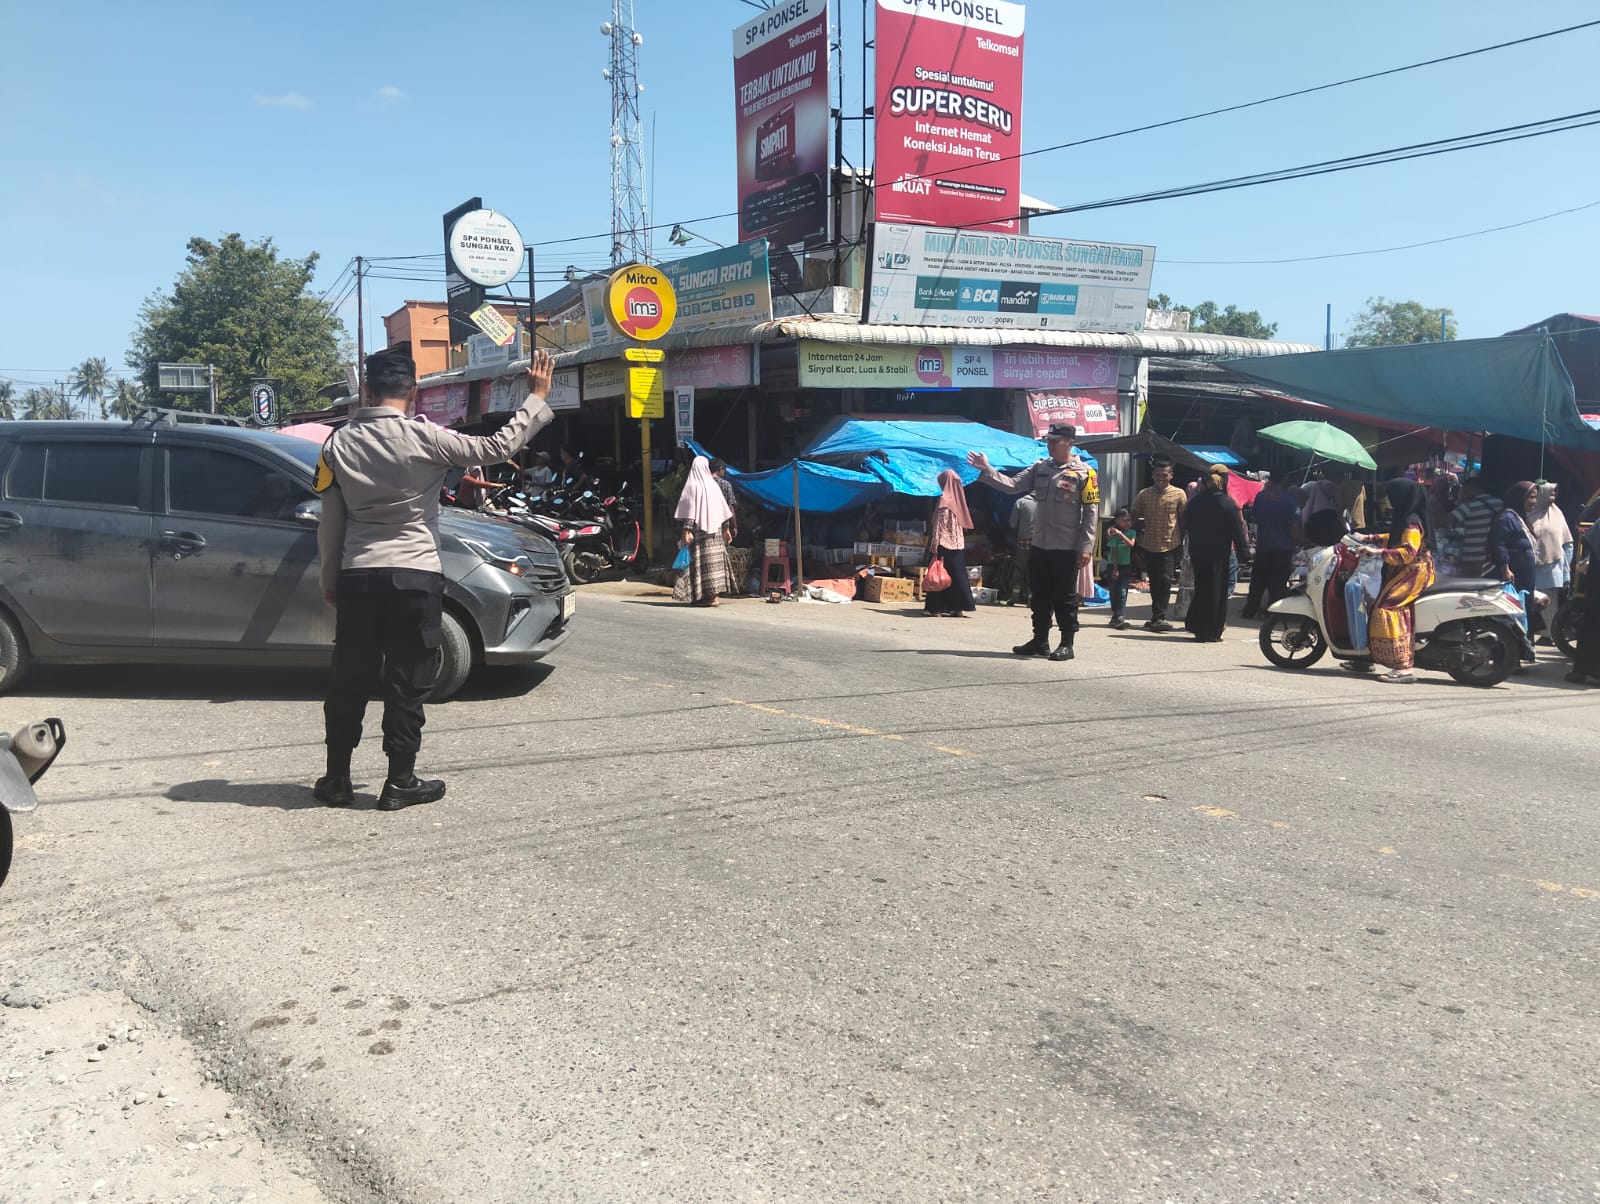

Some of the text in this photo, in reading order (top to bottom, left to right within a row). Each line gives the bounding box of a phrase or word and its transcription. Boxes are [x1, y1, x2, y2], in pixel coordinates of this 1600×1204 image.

[941, 0, 1003, 25] PONSEL
[745, 0, 809, 45] SP 4 PONSEL
[787, 24, 823, 48] Telkomsel
[975, 37, 1019, 57] Telkomsel
[740, 50, 817, 106] TERBAIK UNTUKMU
[915, 66, 994, 91] Spesial untukmu!
[890, 87, 1012, 132] SUPER SERU
[915, 120, 992, 144] Internet Hemat
[760, 124, 788, 159] SIMPATI
[903, 136, 1001, 161] Koneksi Jalan Terus
[901, 181, 932, 196] KUAT
[460, 241, 515, 252] SUNGAI RAYA
[463, 234, 512, 245] SP4 PONSEL
[924, 231, 957, 254] MINI
[957, 235, 989, 256] ATM
[1017, 239, 1063, 261] PONSEL
[1064, 242, 1110, 266] SUNGAI
[1110, 246, 1143, 267] RAYA
[626, 273, 658, 285] Mitra
[679, 260, 753, 292] SUNGAI RAYA
[872, 285, 889, 298] BSI
[918, 287, 955, 297] Bank Aceh
[973, 288, 999, 304] BCA
[1050, 293, 1065, 301] BANK
[630, 298, 658, 315] im3
[967, 315, 985, 324] OVO
[994, 316, 1014, 325] gopay
[808, 352, 883, 362] Internetan 24 Jam
[919, 356, 941, 372] im3
[964, 355, 981, 364] SP 4
[1003, 352, 1081, 368] Tri lebih hemat,
[808, 365, 908, 375] Sinyal Kuat, Luas & Stabil
[956, 367, 989, 376] PONSEL
[1003, 367, 1068, 381] sinyal cepat!
[1033, 398, 1079, 411] SUPER SERU
